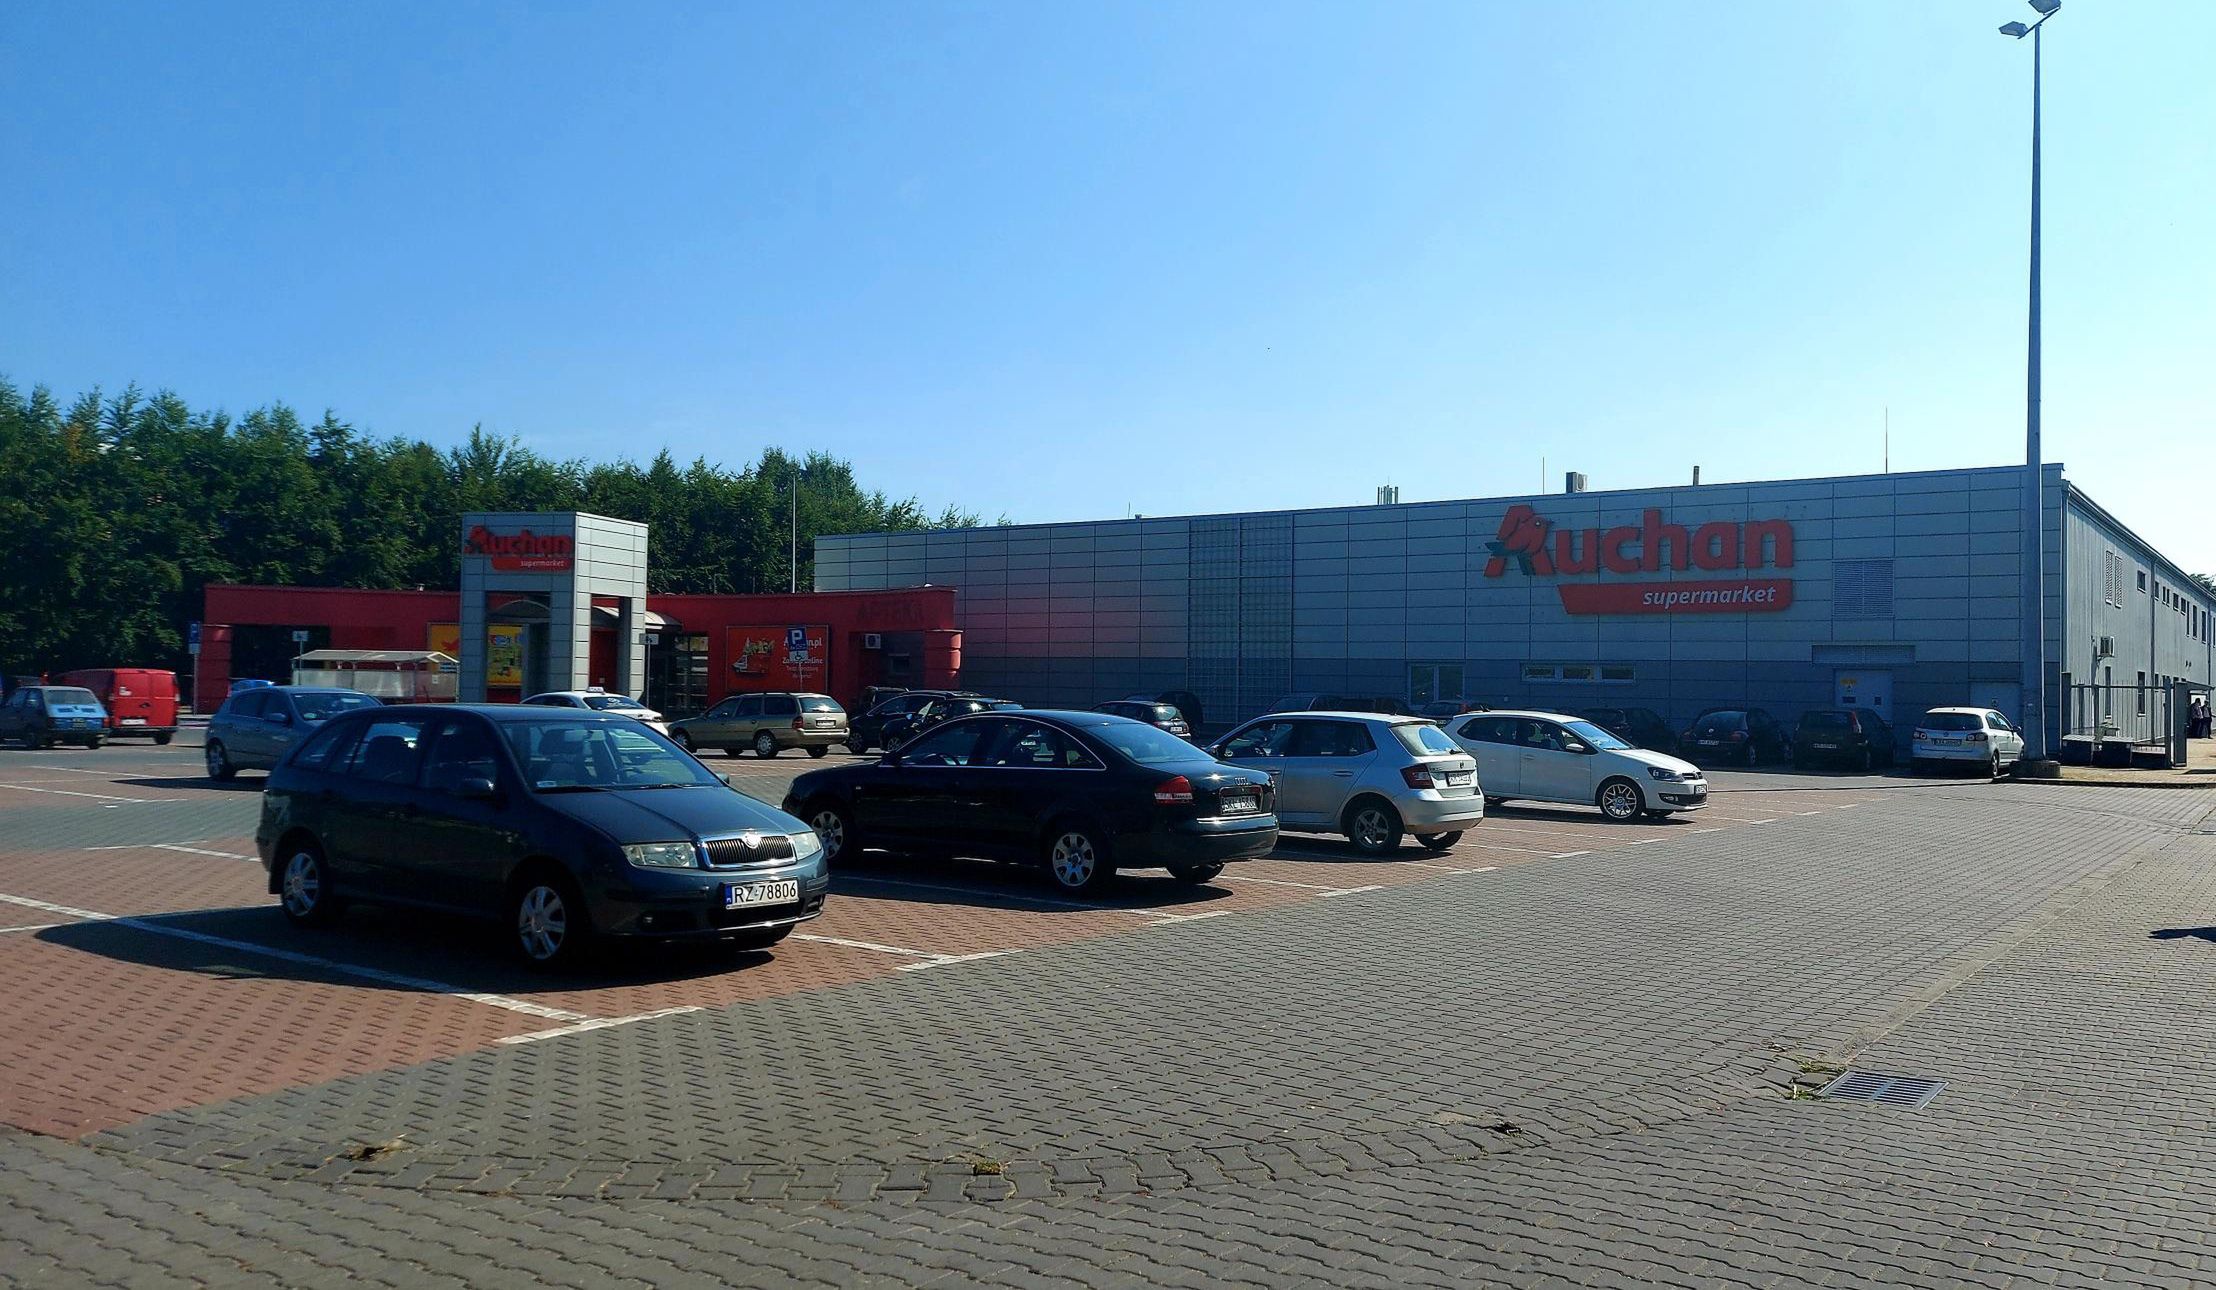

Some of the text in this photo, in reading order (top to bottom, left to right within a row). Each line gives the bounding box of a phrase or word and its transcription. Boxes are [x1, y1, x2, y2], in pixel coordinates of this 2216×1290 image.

[464, 526, 572, 554] Auchan
[1484, 504, 1795, 577] Auchan
[520, 559, 565, 567] supermarket
[1642, 585, 1776, 610] supermarket
[783, 637, 822, 648] An.pl
[791, 630, 802, 644] P
[735, 883, 796, 903] RZ 78806
